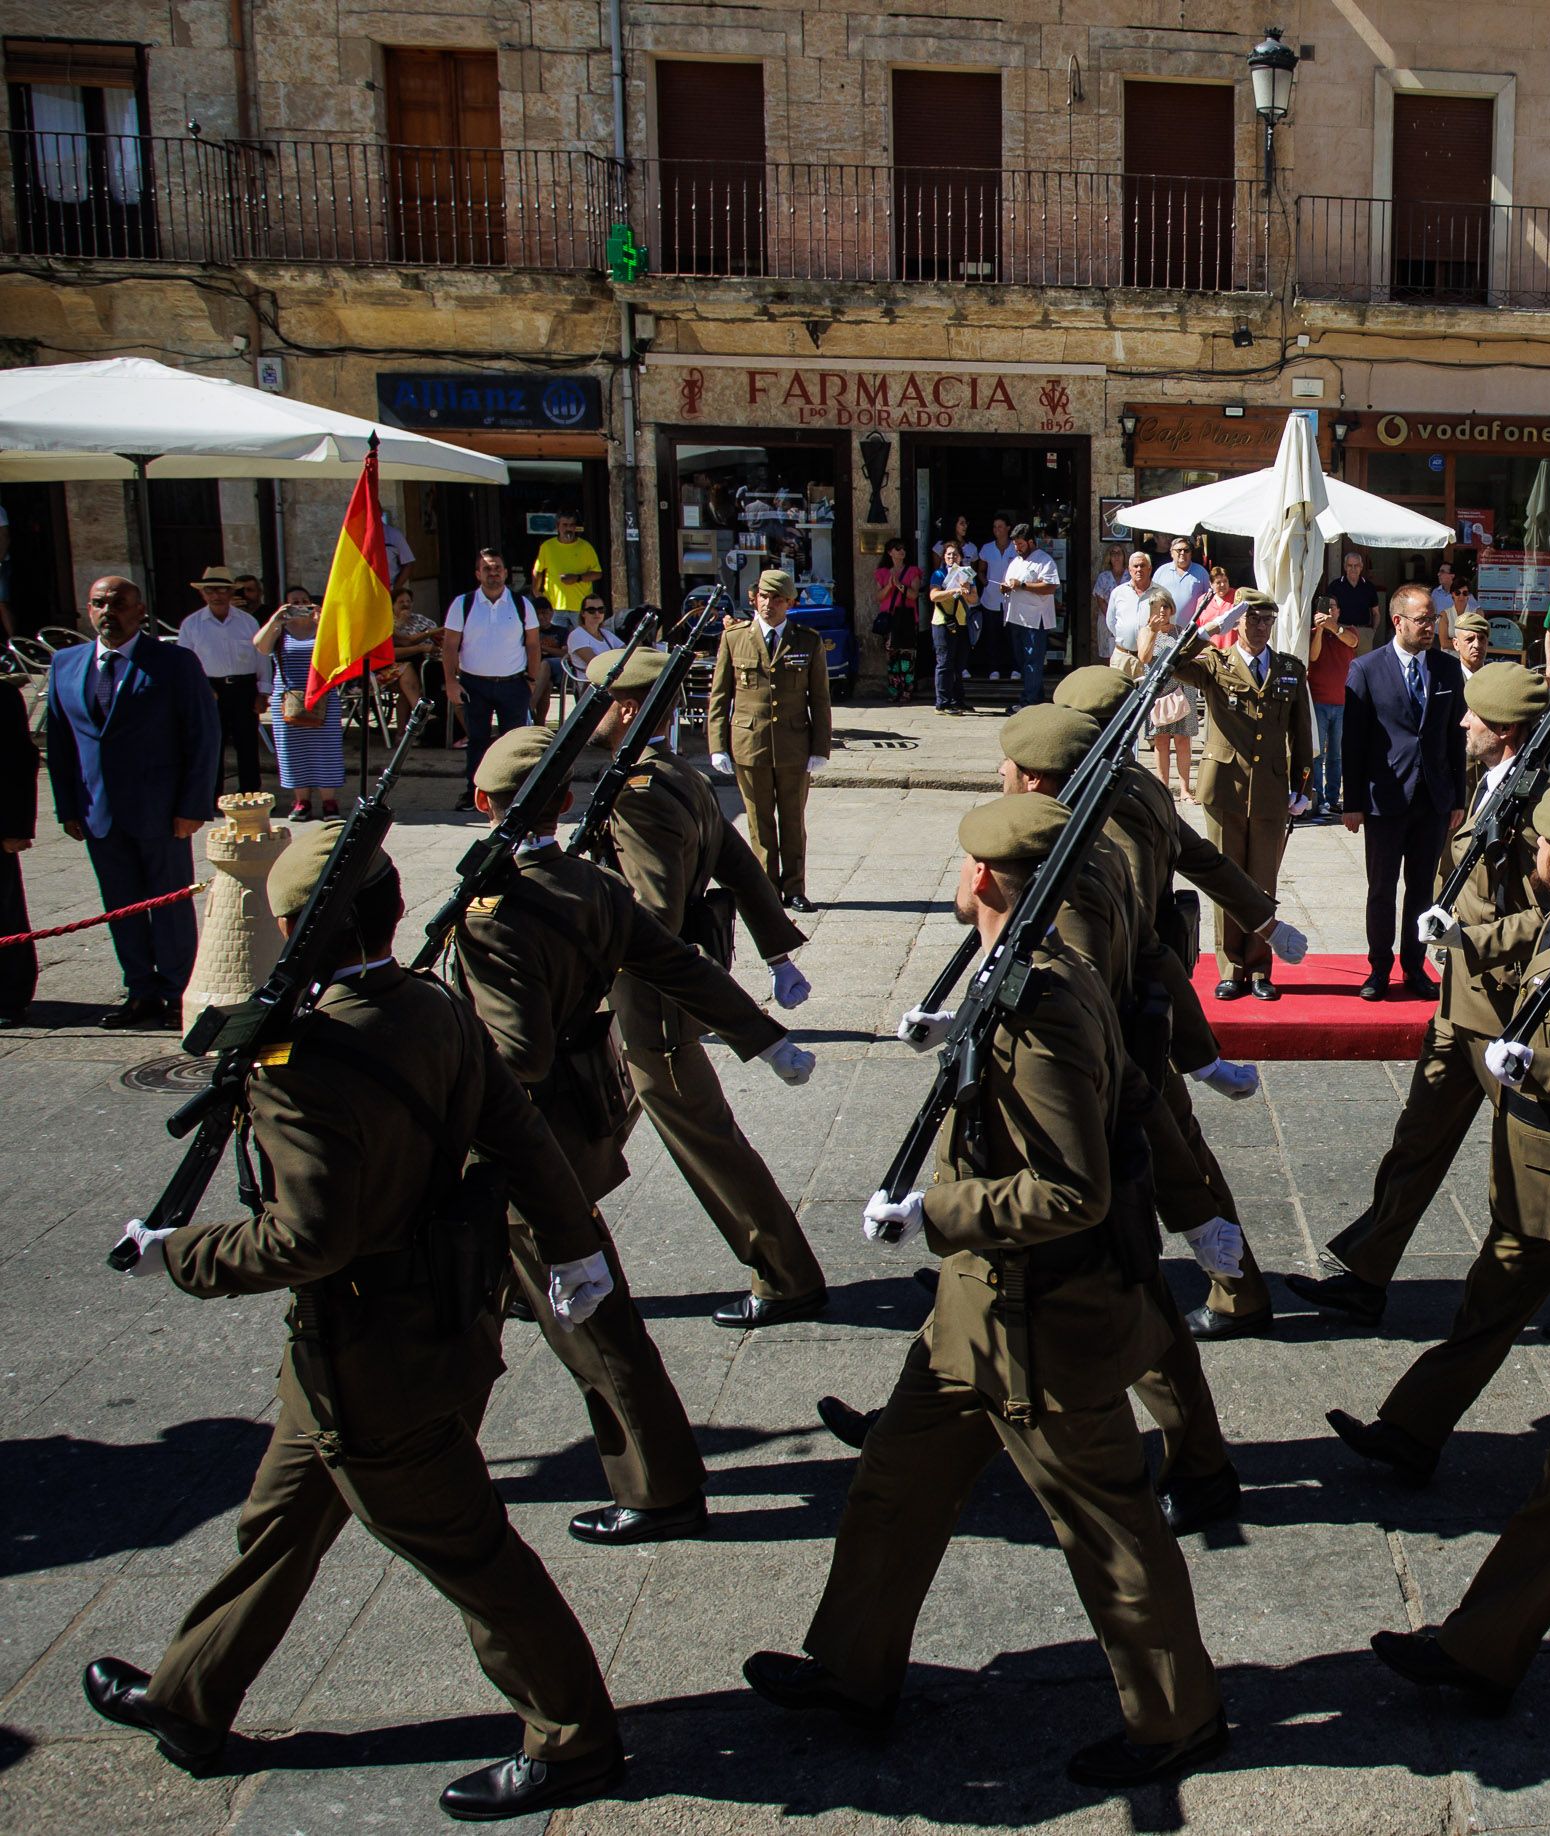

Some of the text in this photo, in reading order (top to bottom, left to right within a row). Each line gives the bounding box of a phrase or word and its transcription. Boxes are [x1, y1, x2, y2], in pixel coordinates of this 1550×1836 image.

[394, 379, 528, 412] Allianz
[746, 369, 1017, 411] FARMACIA
[836, 407, 953, 428] DORADO
[1040, 416, 1074, 433] 1856
[1138, 416, 1193, 452] Café
[1198, 422, 1252, 448] Plaza
